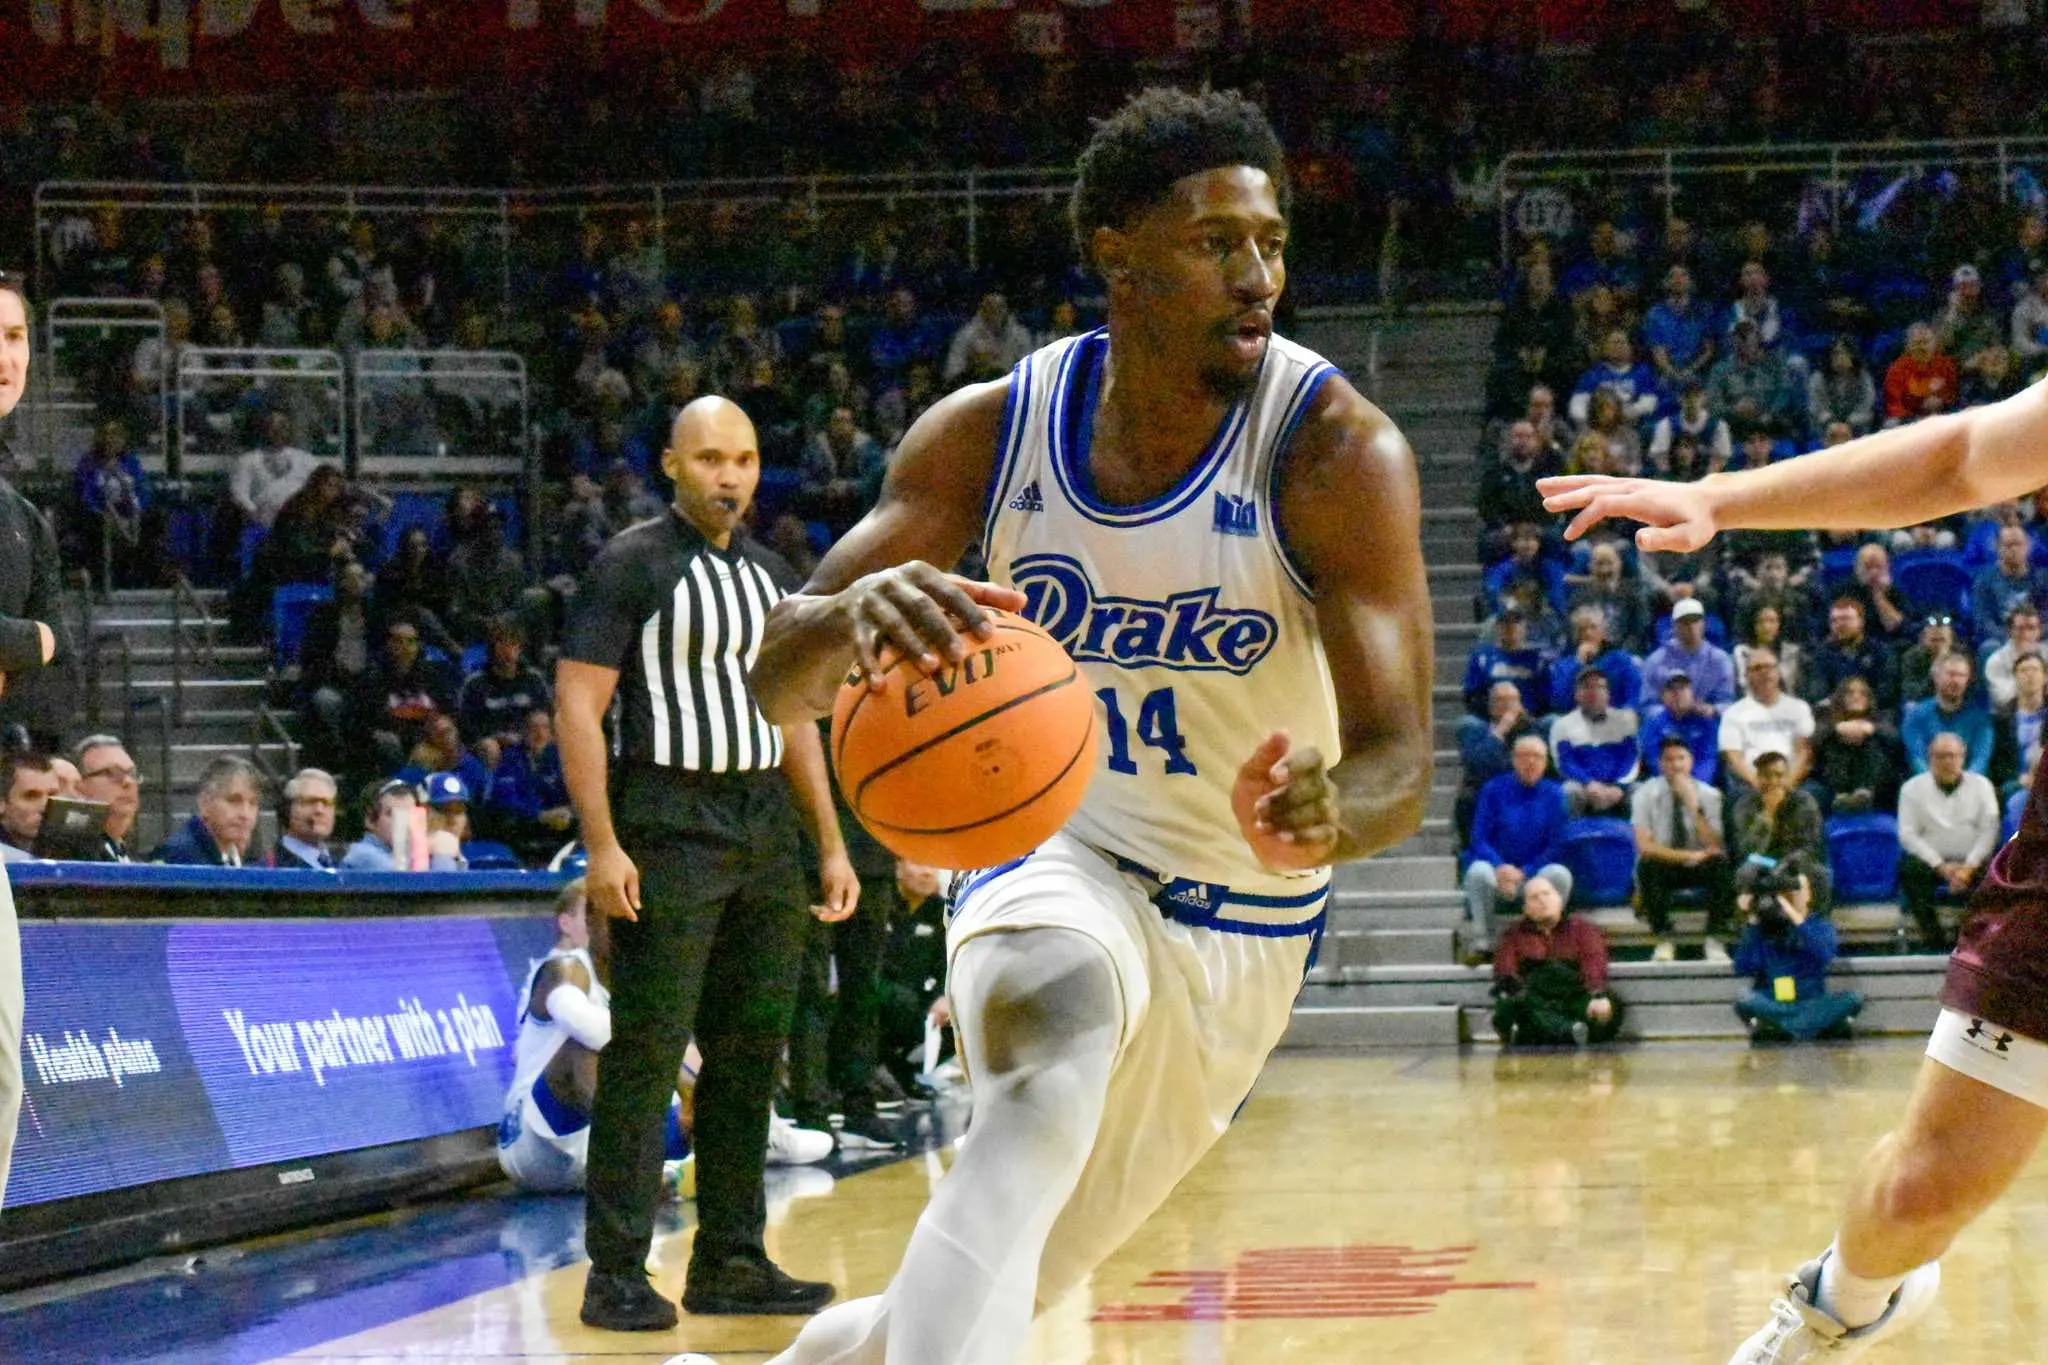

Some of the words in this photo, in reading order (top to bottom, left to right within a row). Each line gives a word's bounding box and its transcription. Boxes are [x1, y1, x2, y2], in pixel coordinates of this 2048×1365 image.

[1009, 553, 1278, 676] Drake
[904, 647, 995, 718] EVO
[1095, 686, 1198, 776] 14
[26, 1029, 109, 1085] Health
[101, 1026, 162, 1089] plans
[222, 1007, 303, 1076] Your
[295, 1007, 396, 1087] partner
[384, 996, 446, 1060] with
[436, 1008, 461, 1054] a
[450, 992, 505, 1067] plan
